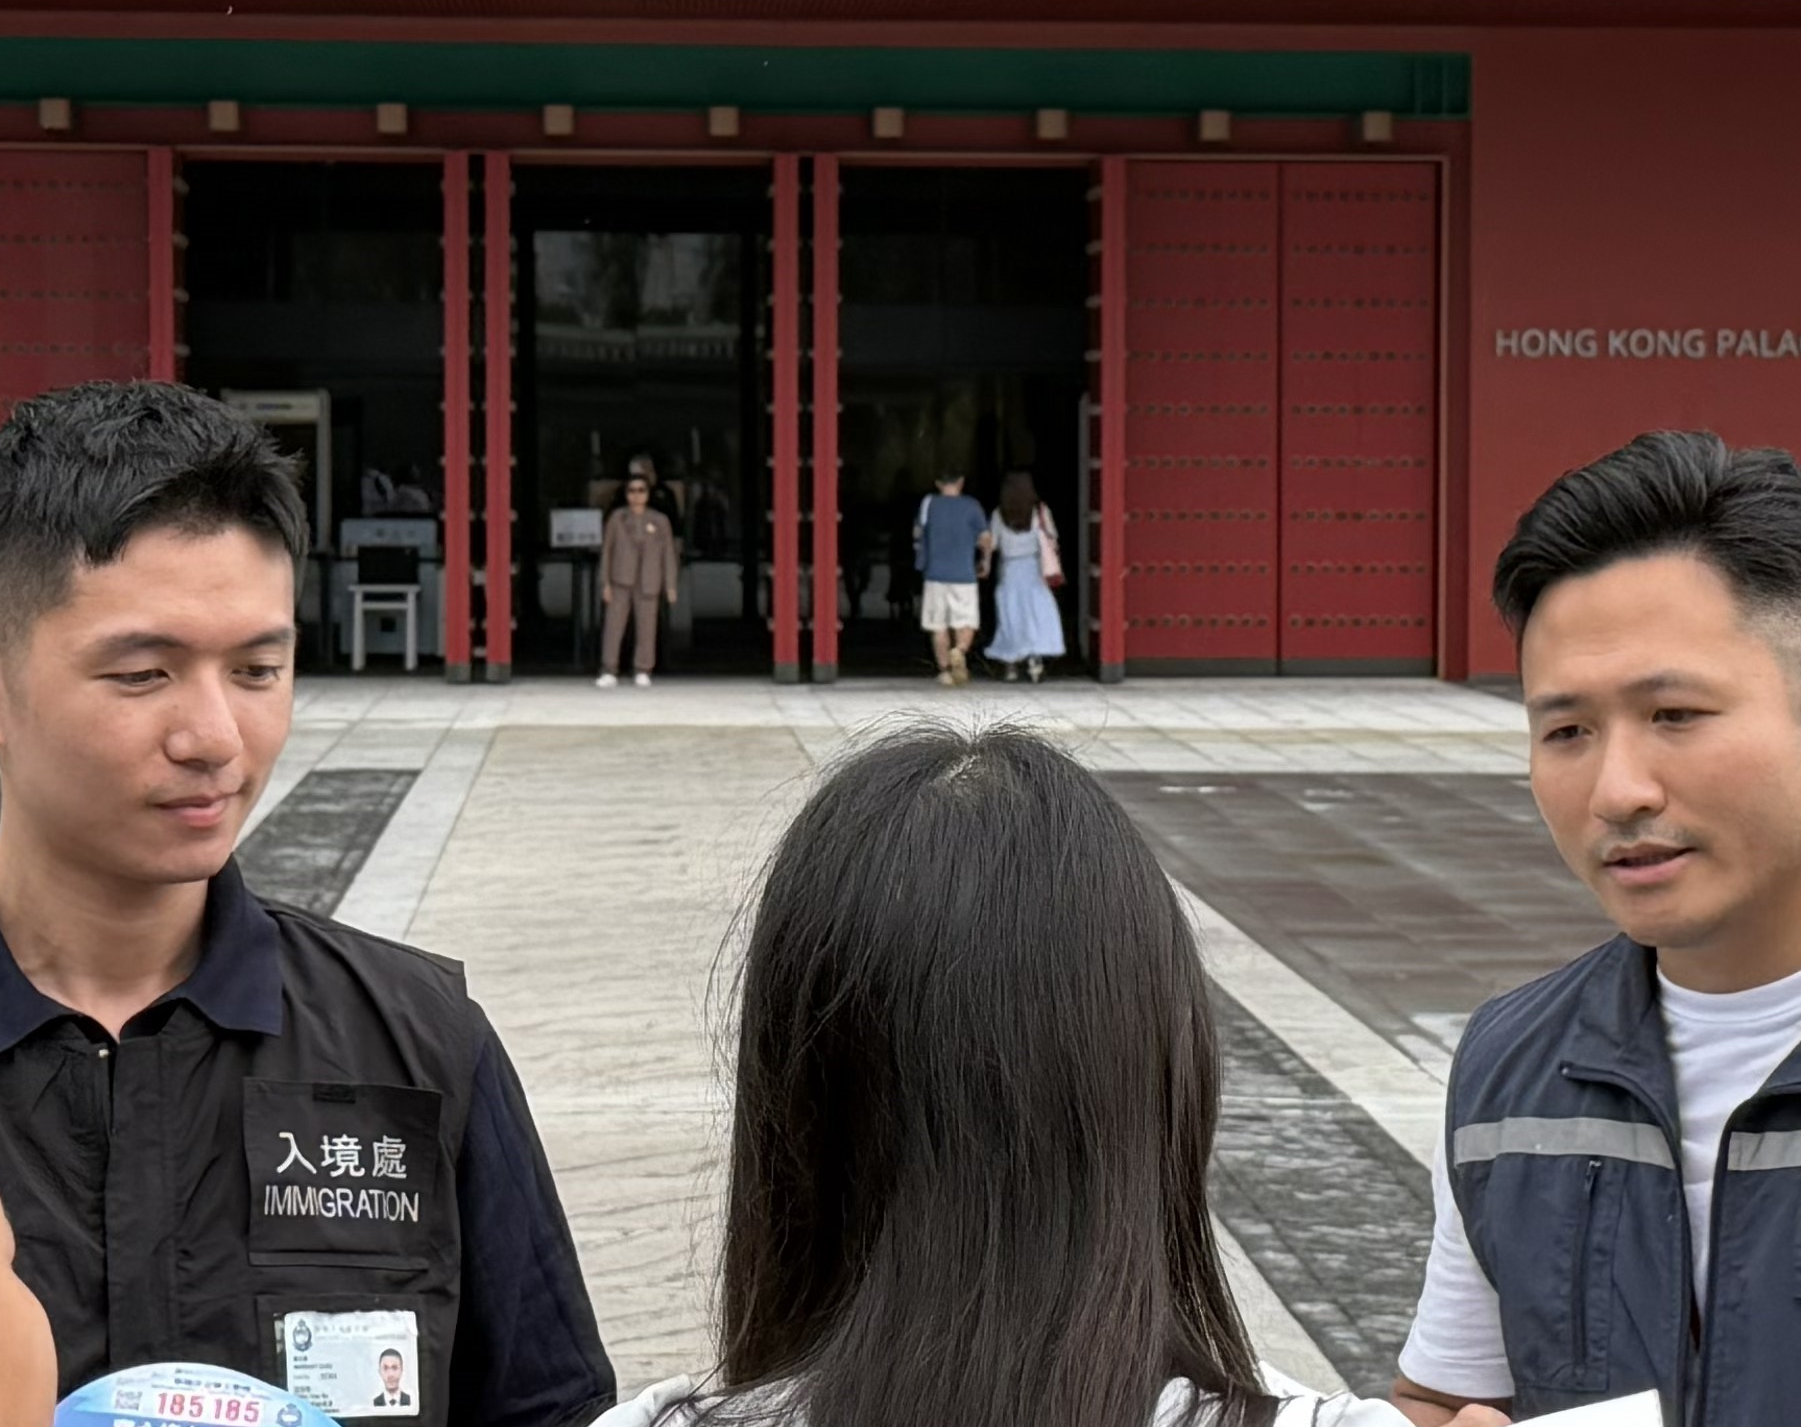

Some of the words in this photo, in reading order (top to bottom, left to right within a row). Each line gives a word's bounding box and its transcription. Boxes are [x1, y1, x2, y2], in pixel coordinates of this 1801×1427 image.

[1496, 329, 1598, 358] HONG
[1608, 329, 1706, 358] KONG
[276, 1132, 407, 1179] 入境處
[264, 1185, 419, 1223] IMMIGRATION
[157, 1392, 205, 1418] 185
[214, 1398, 260, 1423] 185
